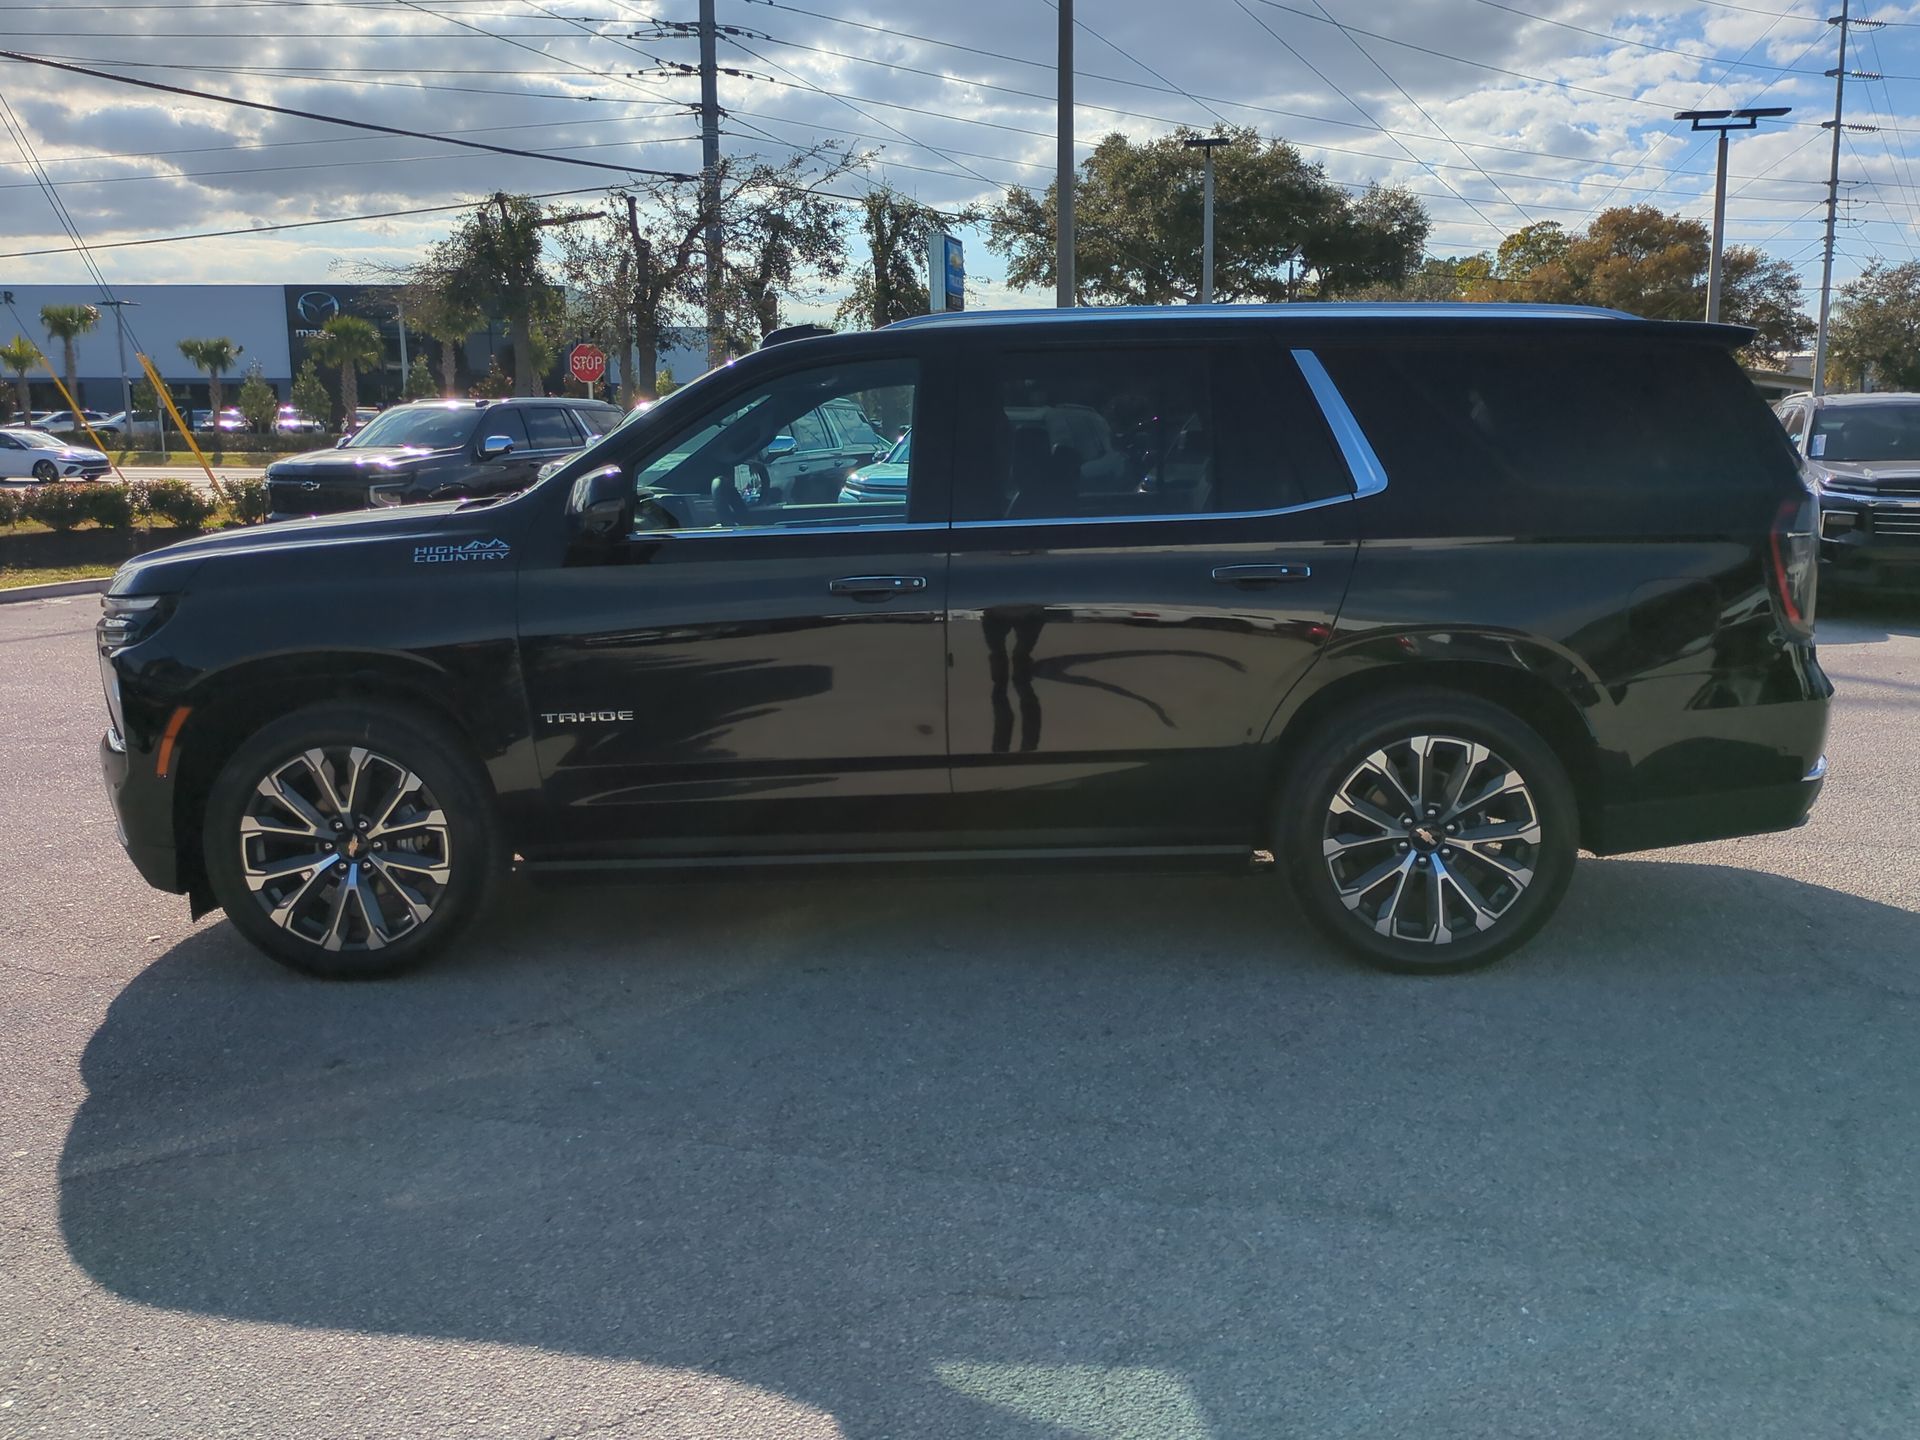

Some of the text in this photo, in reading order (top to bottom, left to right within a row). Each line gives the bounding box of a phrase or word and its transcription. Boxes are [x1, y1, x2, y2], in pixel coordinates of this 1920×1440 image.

[0, 291, 16, 304] R
[573, 356, 603, 370] STOP
[414, 545, 462, 555] HIGH
[413, 551, 510, 563] COUNTRY
[540, 710, 634, 724] TAHOE
